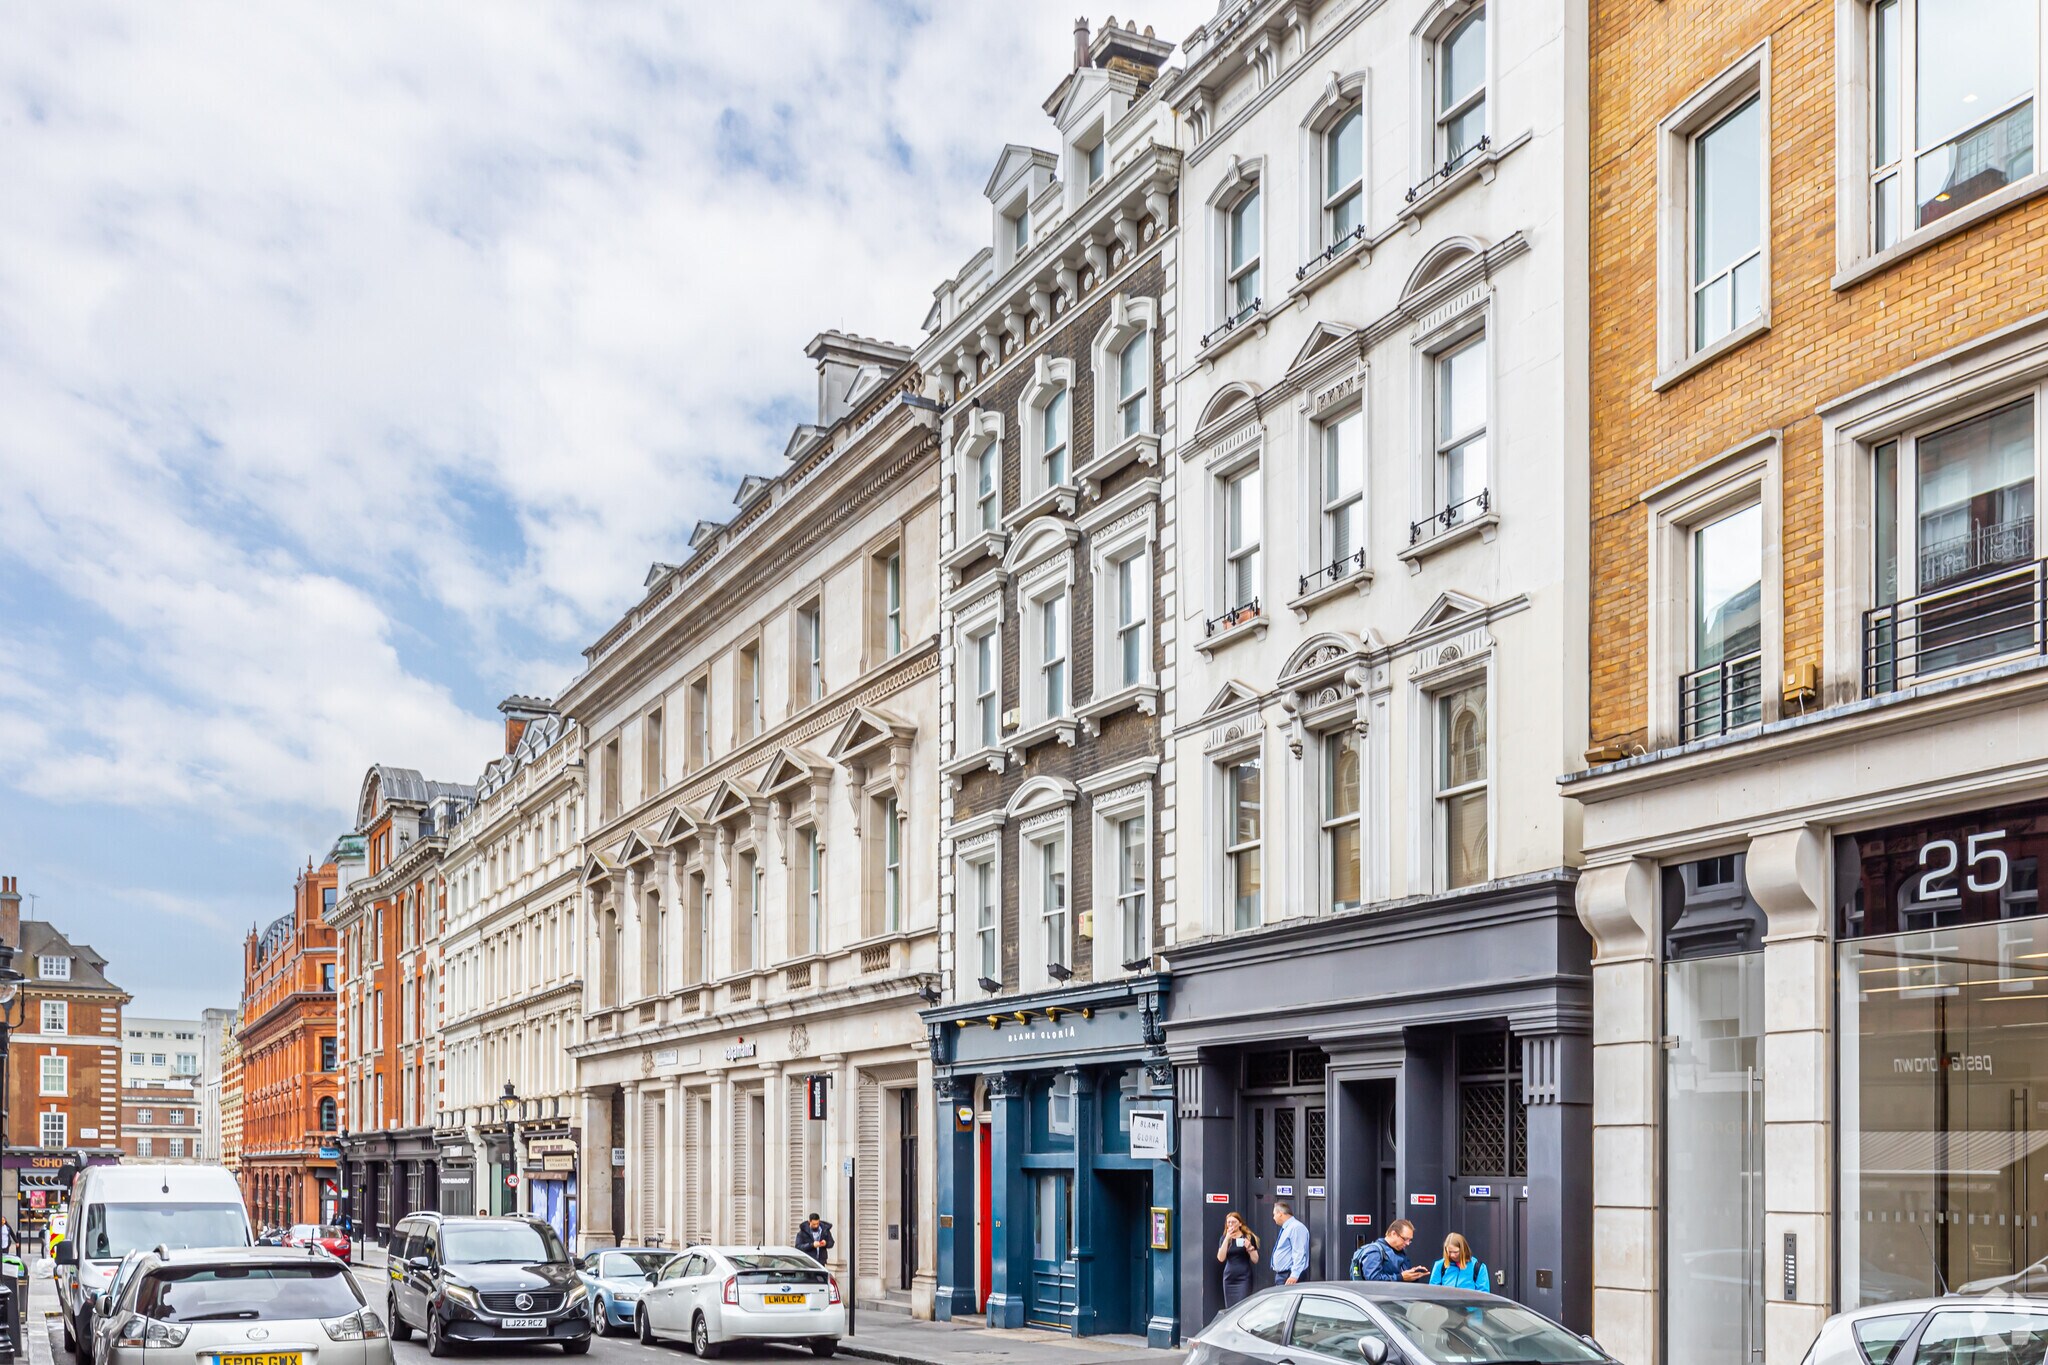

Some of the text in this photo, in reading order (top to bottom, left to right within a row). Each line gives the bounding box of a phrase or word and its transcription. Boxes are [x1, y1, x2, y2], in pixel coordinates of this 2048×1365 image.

[1919, 829, 2008, 901] 25
[1008, 1026, 1075, 1042] BLAME GLORIA
[1140, 1120, 1159, 1130] BLAME
[1137, 1133, 1160, 1144] GLORIA
[32, 1158, 63, 1168] SOHO
[768, 1295, 802, 1304] LW14 LCZ
[505, 1319, 543, 1327] LJ22 RCZ
